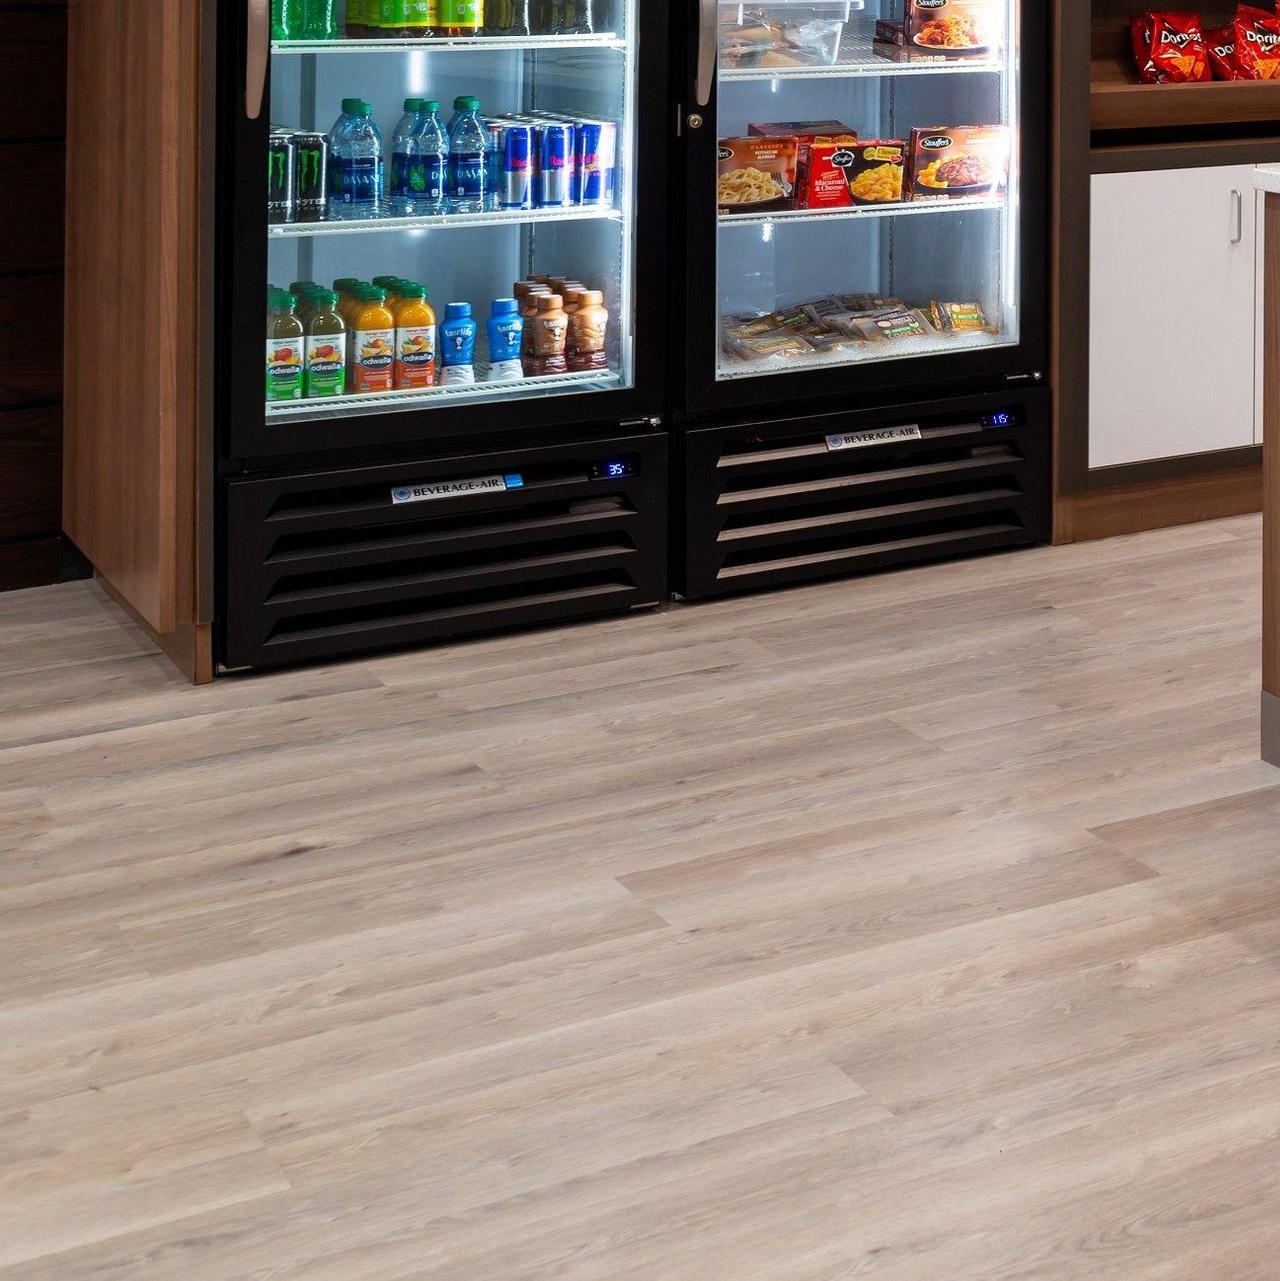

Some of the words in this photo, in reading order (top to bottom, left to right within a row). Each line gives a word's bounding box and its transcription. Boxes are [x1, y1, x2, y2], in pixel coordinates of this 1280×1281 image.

[1161, 30, 1202, 44] Doritos
[343, 173, 380, 186] DASAN
[457, 167, 488, 180] DASAN
[814, 178, 845, 186] Macaroni
[843, 428, 916, 444] BEVERAGE-AIR
[413, 478, 501, 497] BEVERAGE-AIR
